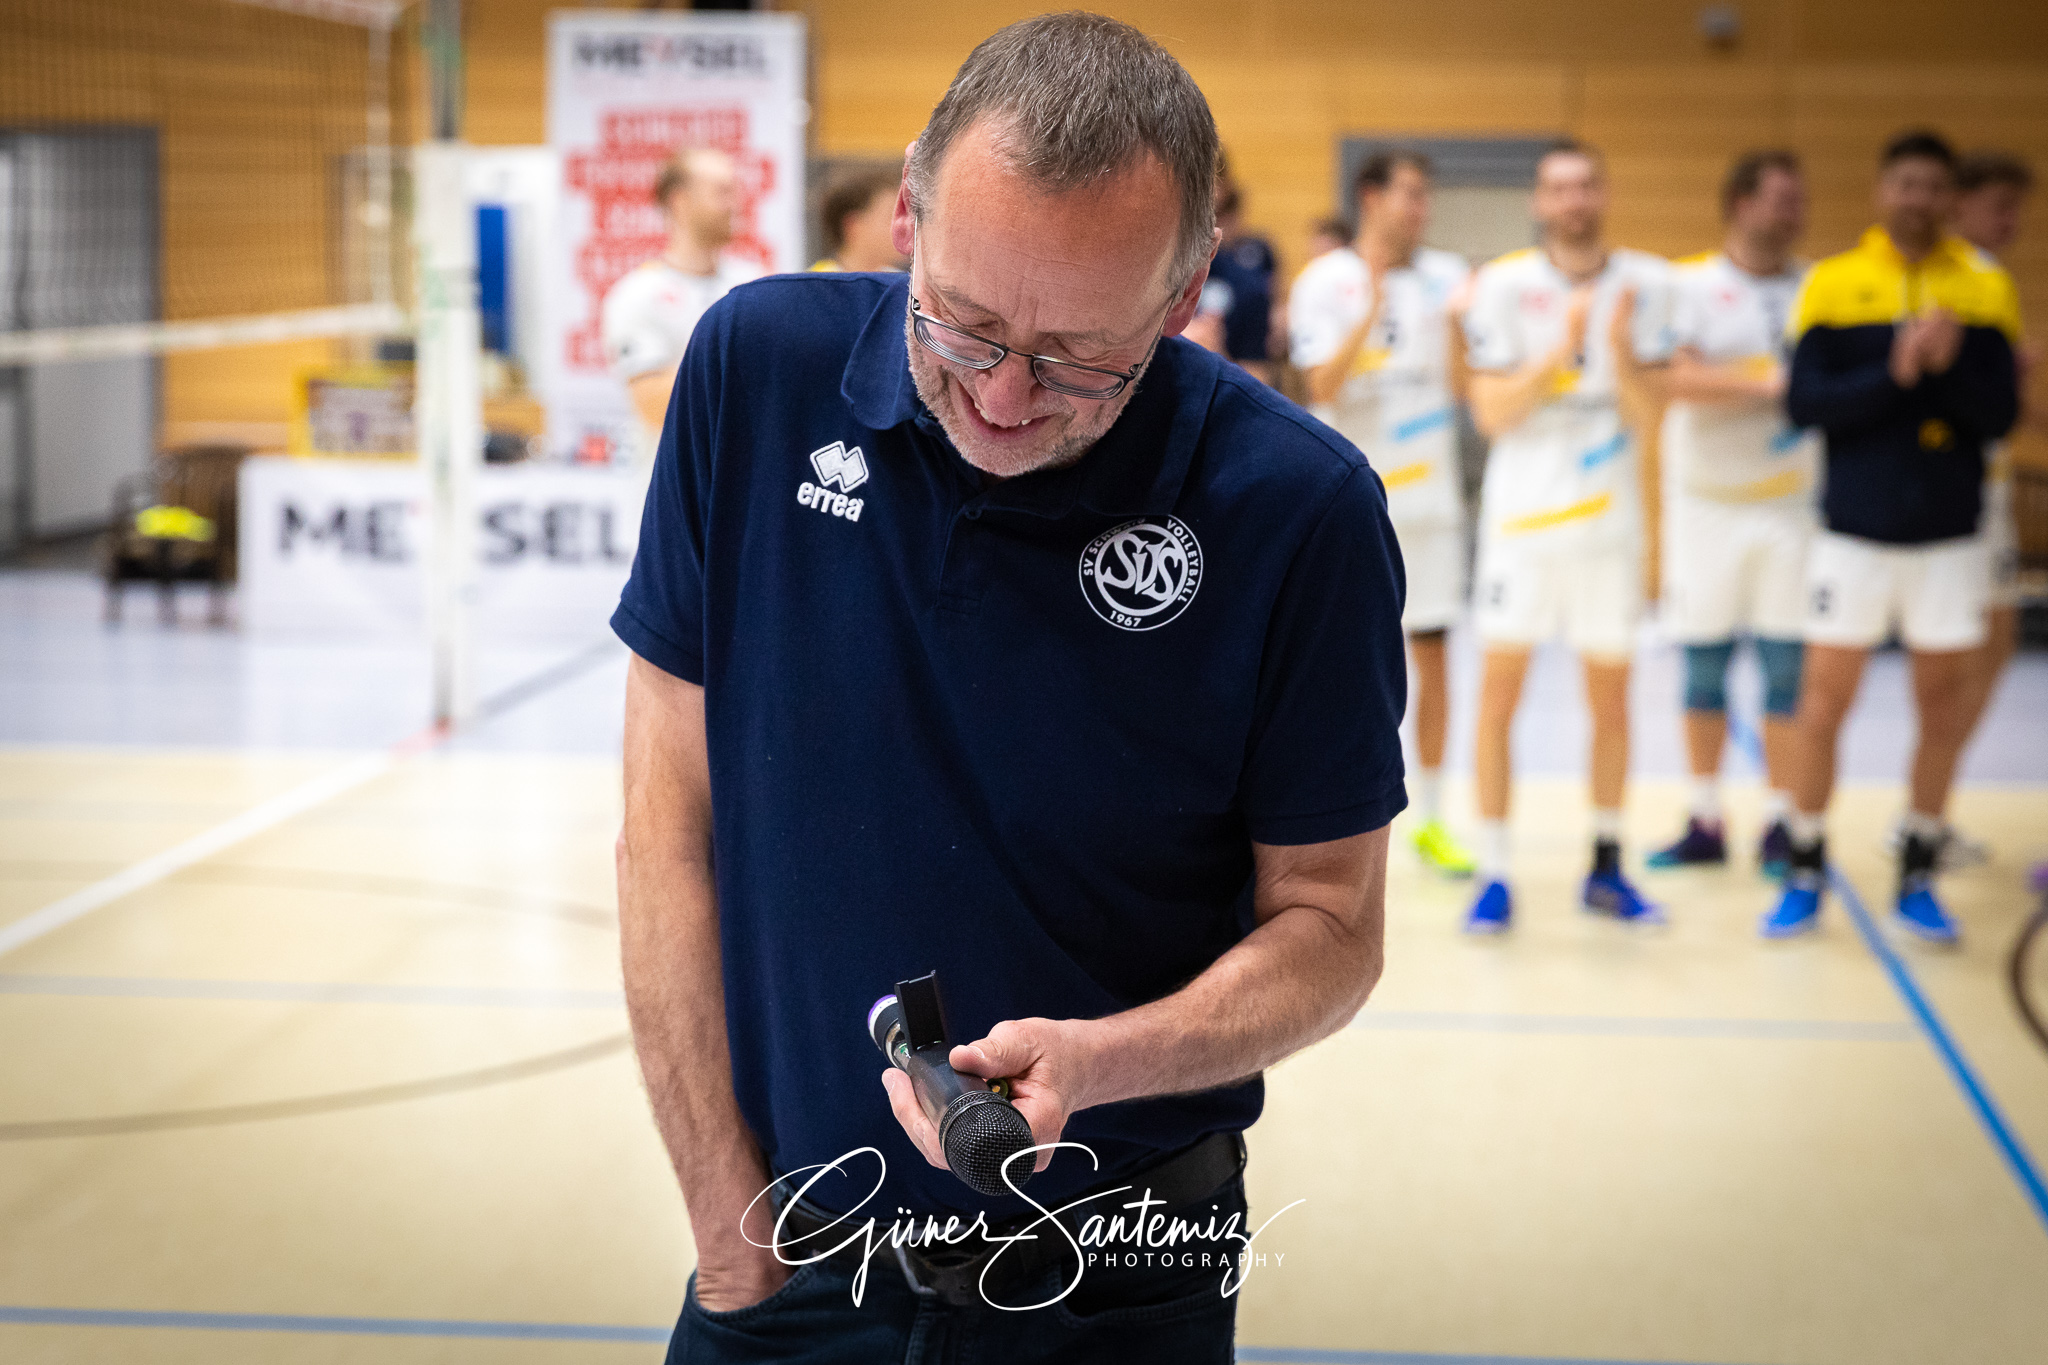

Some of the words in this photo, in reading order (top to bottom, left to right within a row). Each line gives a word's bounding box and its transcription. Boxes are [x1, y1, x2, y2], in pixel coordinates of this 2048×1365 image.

[276, 500, 630, 564] MESEL
[1083, 559, 1094, 576] SV
[1167, 520, 1199, 602] VOLLEYBALL
[1110, 610, 1142, 627] 1967
